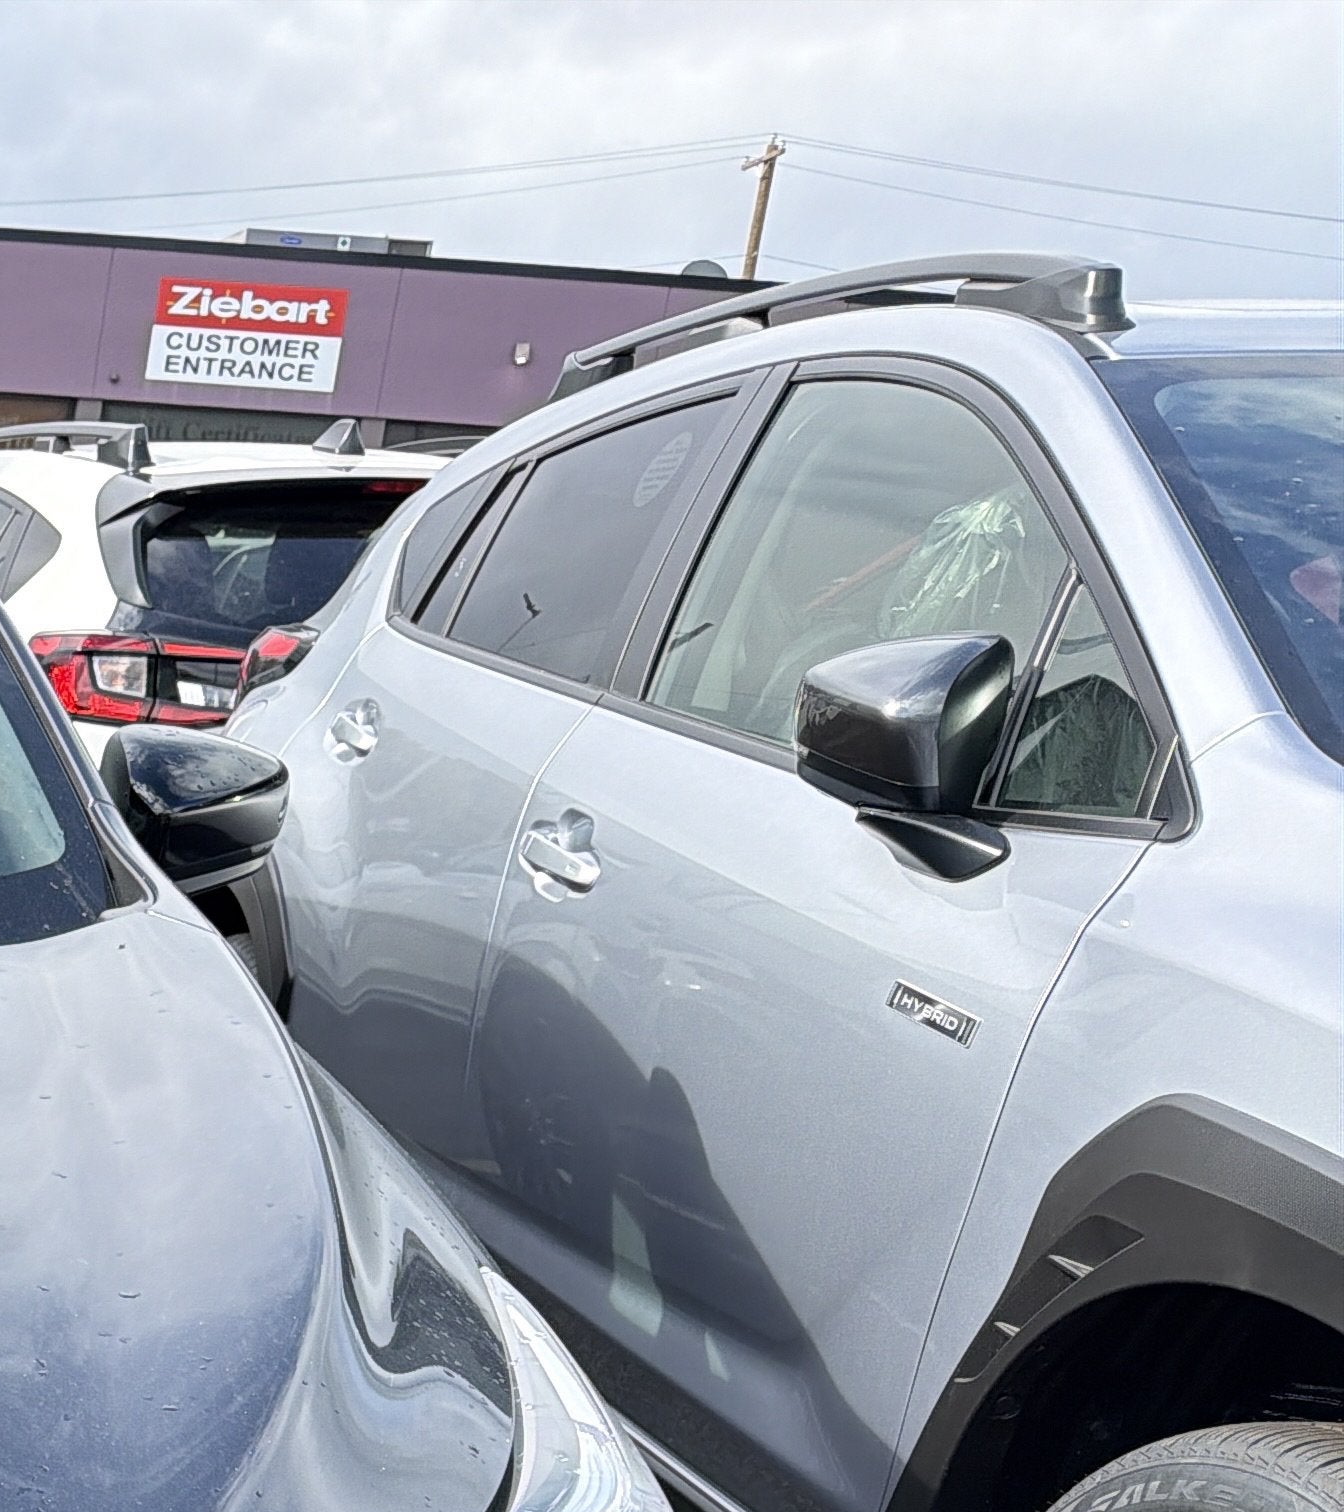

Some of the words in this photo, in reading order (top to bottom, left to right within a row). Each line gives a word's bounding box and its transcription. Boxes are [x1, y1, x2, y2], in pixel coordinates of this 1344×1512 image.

[167, 285, 331, 325] Ziebart
[165, 331, 320, 361] CUSTOMER
[163, 354, 316, 383] ENTRANCE
[901, 993, 958, 1030] HYBRID
